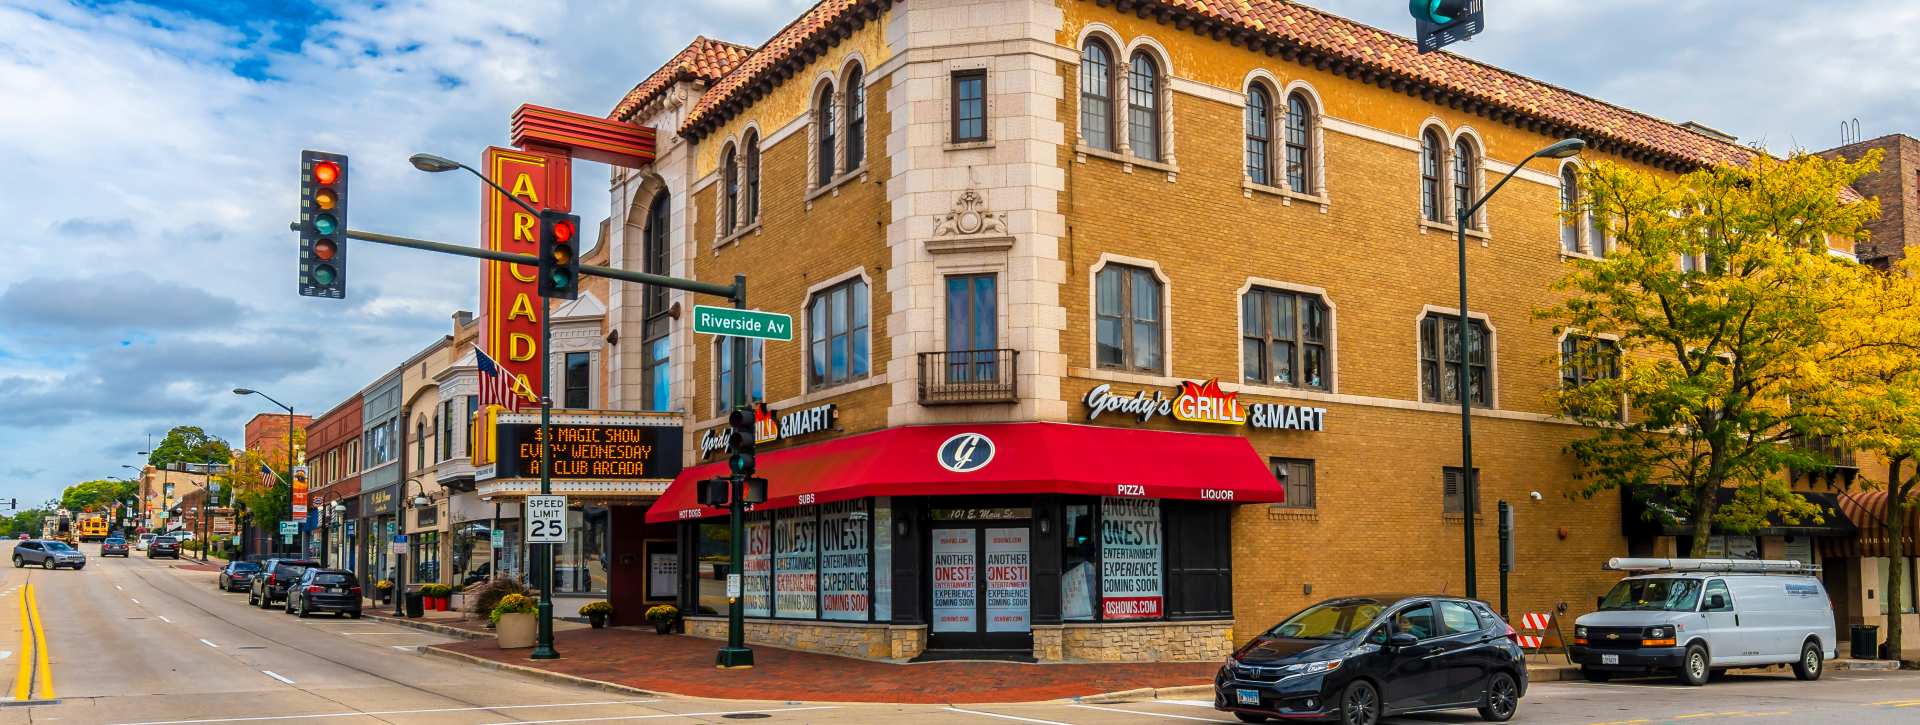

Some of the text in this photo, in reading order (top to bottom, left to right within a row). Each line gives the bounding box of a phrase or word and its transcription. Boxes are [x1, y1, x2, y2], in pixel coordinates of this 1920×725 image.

[507, 173, 539, 403] ARCADA
[701, 313, 785, 334] Riverside Av
[1087, 383, 1327, 431] Gordy's GRILL &MART
[558, 428, 600, 442] MAGIC
[605, 428, 640, 443] SHOW
[701, 403, 831, 460] Gordy' ILL &MART
[520, 444, 652, 459] EVRY WEDNESDAY
[530, 460, 644, 475] A CLUB ARCADA
[1118, 484, 1145, 495] PIZZA
[1201, 489, 1234, 500] LIQUOR
[529, 500, 564, 508] SPEED
[798, 493, 815, 505] SUBS
[679, 508, 702, 519] HOT DOGS
[1102, 497, 1156, 517] ANOTHER
[533, 510, 560, 518] LIMIT
[950, 510, 965, 519] 101
[531, 520, 563, 537] 25
[823, 517, 868, 552] ONEST
[1102, 519, 1159, 545] ONESTI
[935, 554, 974, 565] ANOTHER
[988, 554, 1027, 565] ANOTHER
[1103, 548, 1157, 559] ENTERTAINMENT
[1103, 562, 1158, 576] EXPERIENCE
[1103, 579, 1158, 592] COMING SOON
[935, 589, 975, 598] EXPERIENCE
[988, 589, 1028, 598] EXPERIENCE
[823, 594, 849, 611] COMING
[935, 598, 975, 607] COMING SOON
[988, 598, 1028, 607] COMING SOON
[1105, 600, 1157, 613] OSHOWS.COM
